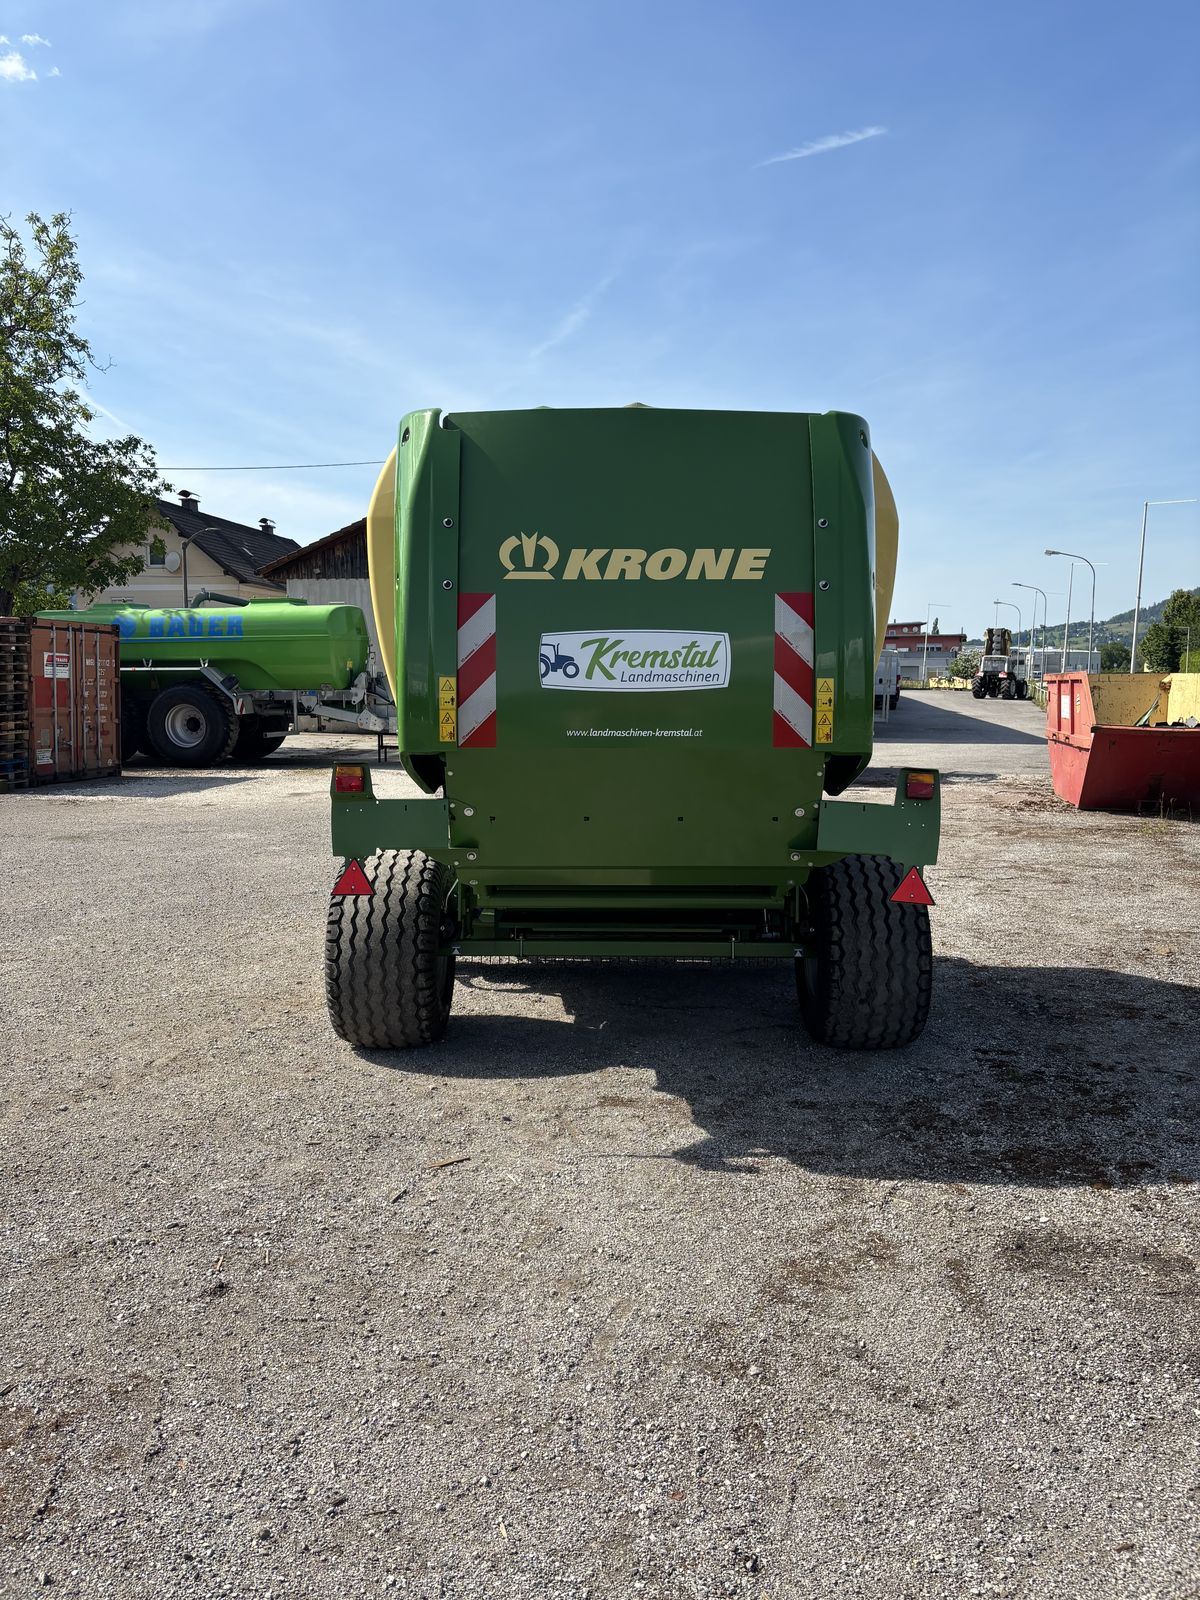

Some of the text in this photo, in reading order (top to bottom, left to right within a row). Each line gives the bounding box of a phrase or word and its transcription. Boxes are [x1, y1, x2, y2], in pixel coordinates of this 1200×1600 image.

[562, 548, 772, 580] KRONE
[148, 615, 243, 637] BAUER
[580, 637, 723, 681] Kremstal
[620, 670, 720, 683] Landmaschinen
[566, 727, 703, 738] www.landmaschinen-kremstal.at
